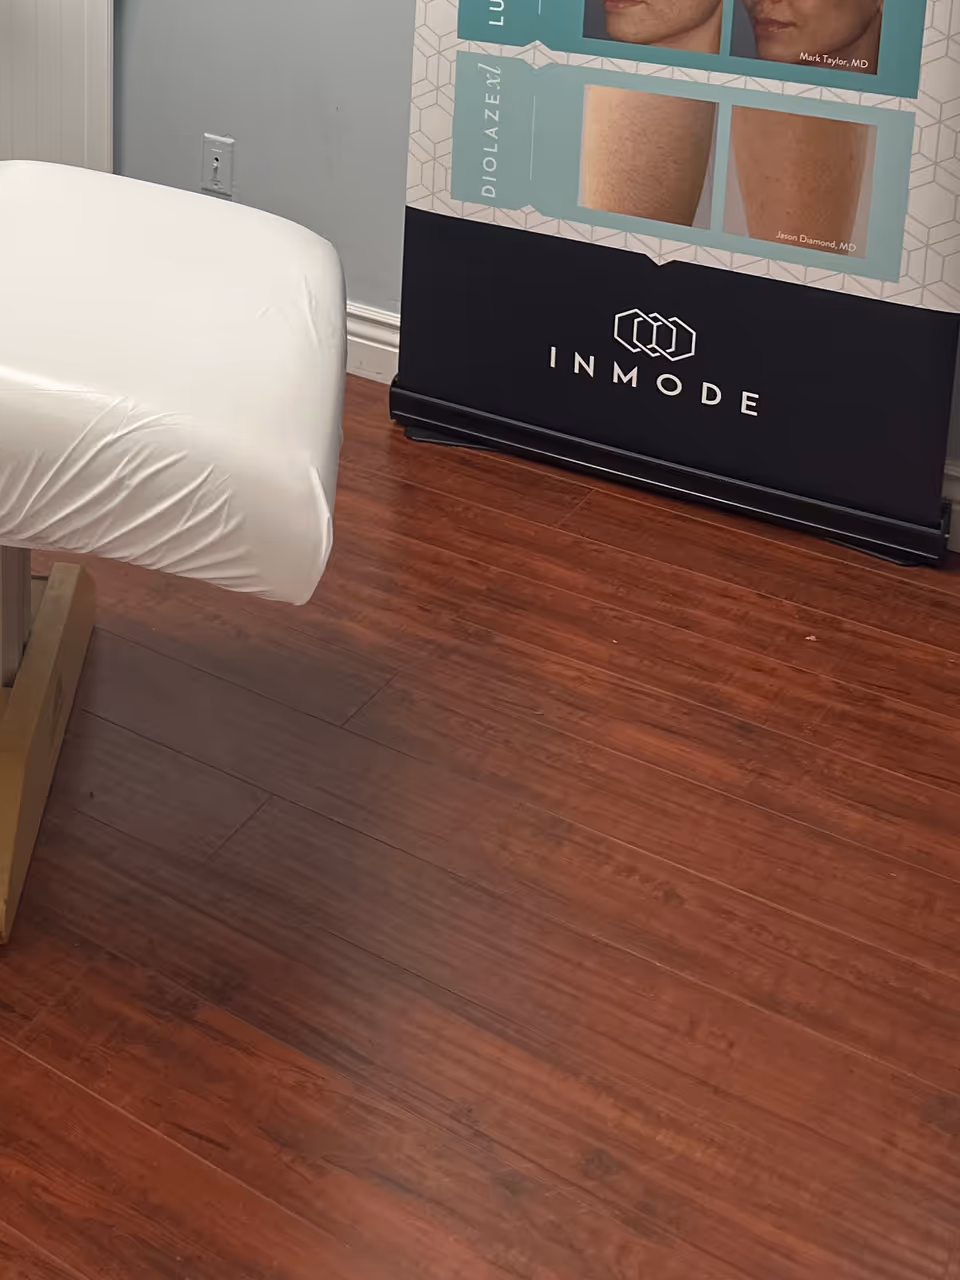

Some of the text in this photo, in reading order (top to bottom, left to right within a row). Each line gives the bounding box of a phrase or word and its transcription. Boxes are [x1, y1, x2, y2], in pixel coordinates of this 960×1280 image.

[799, 52, 868, 68] Mark Taylor, MD
[478, 63, 501, 198] DIOLAZExl
[776, 231, 857, 252] Jason Diamond, MD
[549, 345, 761, 417] INMODE
